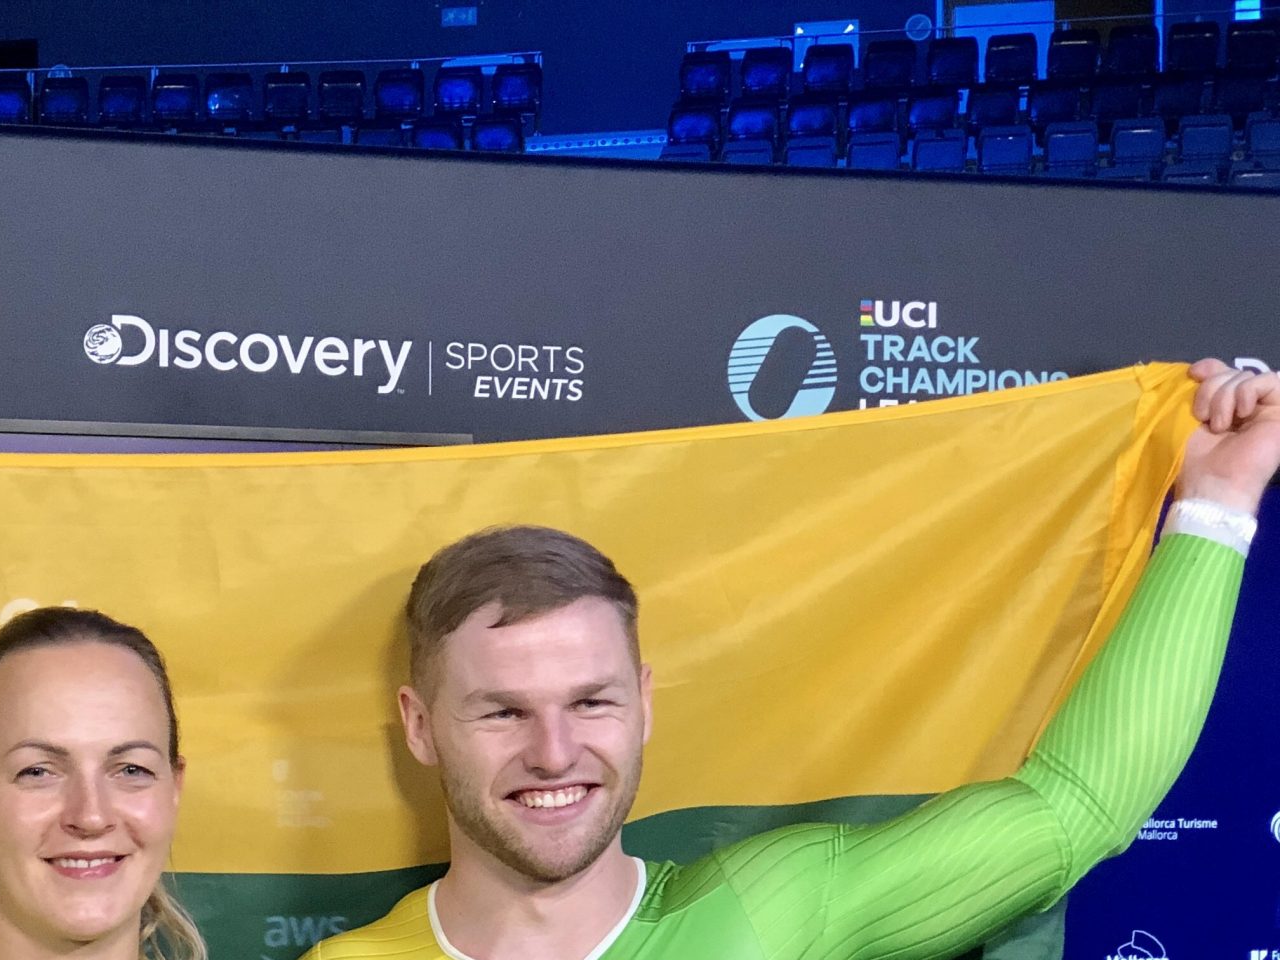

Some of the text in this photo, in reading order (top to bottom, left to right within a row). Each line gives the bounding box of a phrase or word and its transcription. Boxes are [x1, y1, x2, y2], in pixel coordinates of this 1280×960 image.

[874, 300, 937, 328] UCI
[445, 342, 585, 374] SPORTS
[860, 334, 980, 363] TRACK
[473, 376, 584, 402] EVENTS
[1137, 830, 1179, 841] Mallorca
[1177, 818, 1218, 829] Turisme
